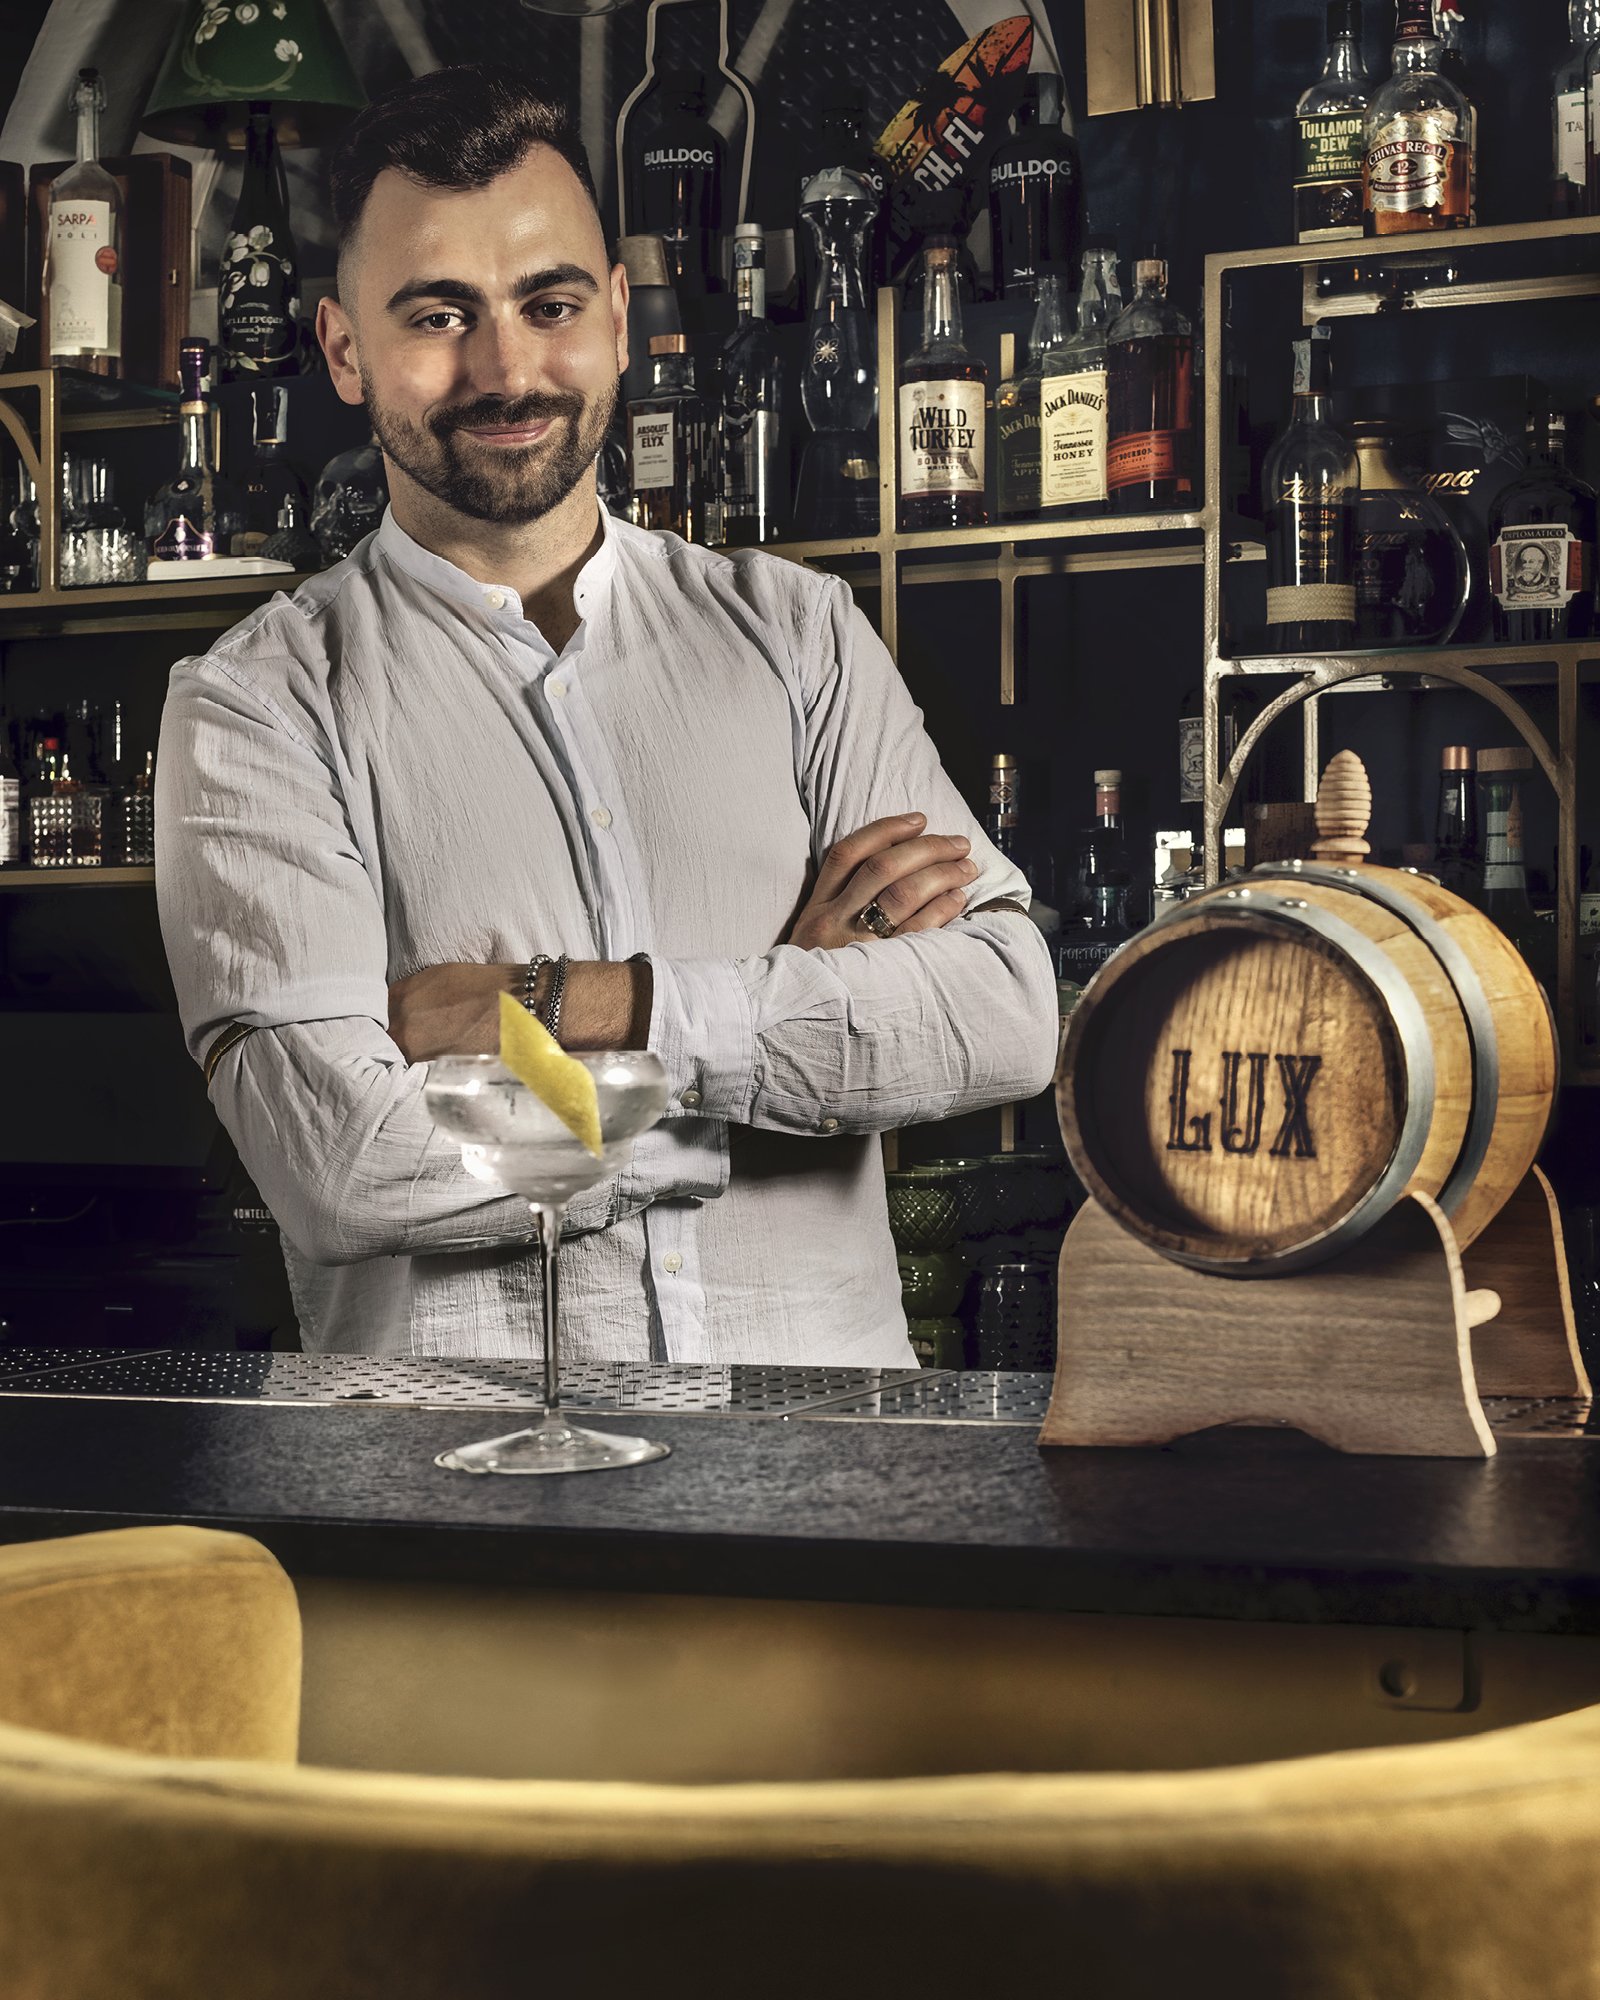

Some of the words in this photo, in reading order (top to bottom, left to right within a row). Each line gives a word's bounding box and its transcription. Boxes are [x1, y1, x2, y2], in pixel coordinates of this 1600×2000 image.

[942, 116, 985, 159] FL
[1299, 119, 1363, 139] TULLAMOR
[644, 148, 714, 166] BULLDOG
[1368, 143, 1403, 166] CHIVAS
[1406, 141, 1443, 158] REGAL
[991, 159, 1072, 183] BULLDOG
[1396, 160, 1409, 174] 12
[1044, 395, 1067, 418] JACK
[1067, 388, 1105, 412] DANIEL'S
[919, 406, 967, 428] WILD
[637, 423, 670, 435] ABSOLUT
[909, 425, 977, 452] TURKEY
[1000, 418, 1024, 441] JACK
[641, 435, 664, 449] ELYX
[1053, 439, 1094, 451] Tennessee
[1053, 449, 1094, 462] HONEY
[1012, 468, 1042, 477] APPL
[1166, 1050, 1322, 1158] LUX
